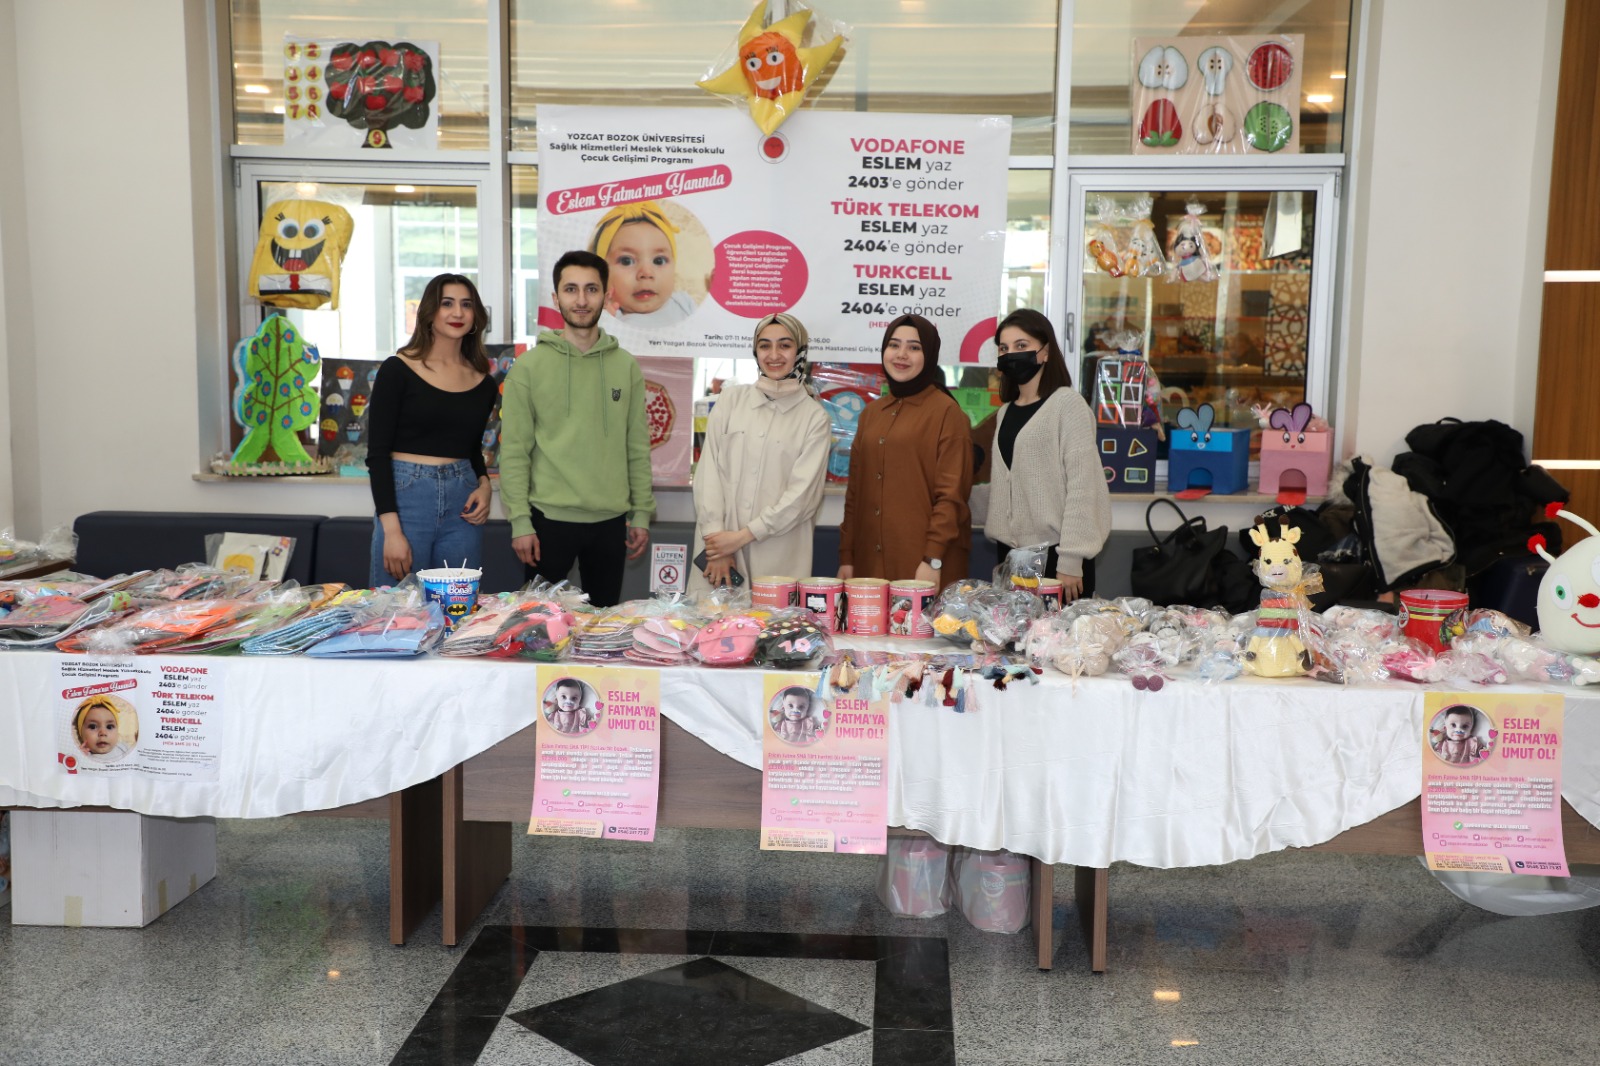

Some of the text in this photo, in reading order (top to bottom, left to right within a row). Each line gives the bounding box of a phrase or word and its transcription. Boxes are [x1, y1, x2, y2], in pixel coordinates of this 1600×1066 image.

[289, 43, 318, 57] 1 2
[308, 66, 317, 80] 4
[289, 86, 318, 100] 5 6
[290, 104, 317, 118] 7 8
[372, 131, 382, 145] 9
[567, 133, 706, 144] YOZGAT BOZOK ÜNİVERSİTESİ
[550, 142, 725, 154] Sağlık Hizmetleri Meslek Yüksekokulu
[850, 138, 965, 155] VODAFONE
[581, 154, 694, 166] Çocuk Gelişimi Programı
[862, 156, 952, 174] ESLEM yaz
[556, 168, 726, 212] Eslem Fatma'nın Yanında
[848, 176, 964, 192] 2403'e gönder
[831, 198, 979, 219] TÜRK TELEKOM
[861, 220, 948, 237] ESLEM yaz
[844, 239, 964, 256] 2404'e gönder
[853, 264, 952, 281] TURKCELL
[858, 283, 946, 300] ESLEM yaz
[841, 302, 962, 318] 2404'e gönder
[778, 638, 811, 653] 10
[160, 666, 208, 674] VODAFONE
[152, 691, 173, 699] TÜRK
[608, 690, 640, 703] ESLEM
[608, 704, 656, 717] FATMA'YA
[836, 699, 868, 710] ESLEM
[608, 718, 655, 731] UMUT OL!
[836, 713, 885, 725] FATMA'YA
[1503, 718, 1540, 730] ESLEM
[836, 727, 884, 739] UMUT OL!
[1503, 733, 1558, 744] FATMA'YA
[1502, 747, 1556, 760] UMUT OL!
